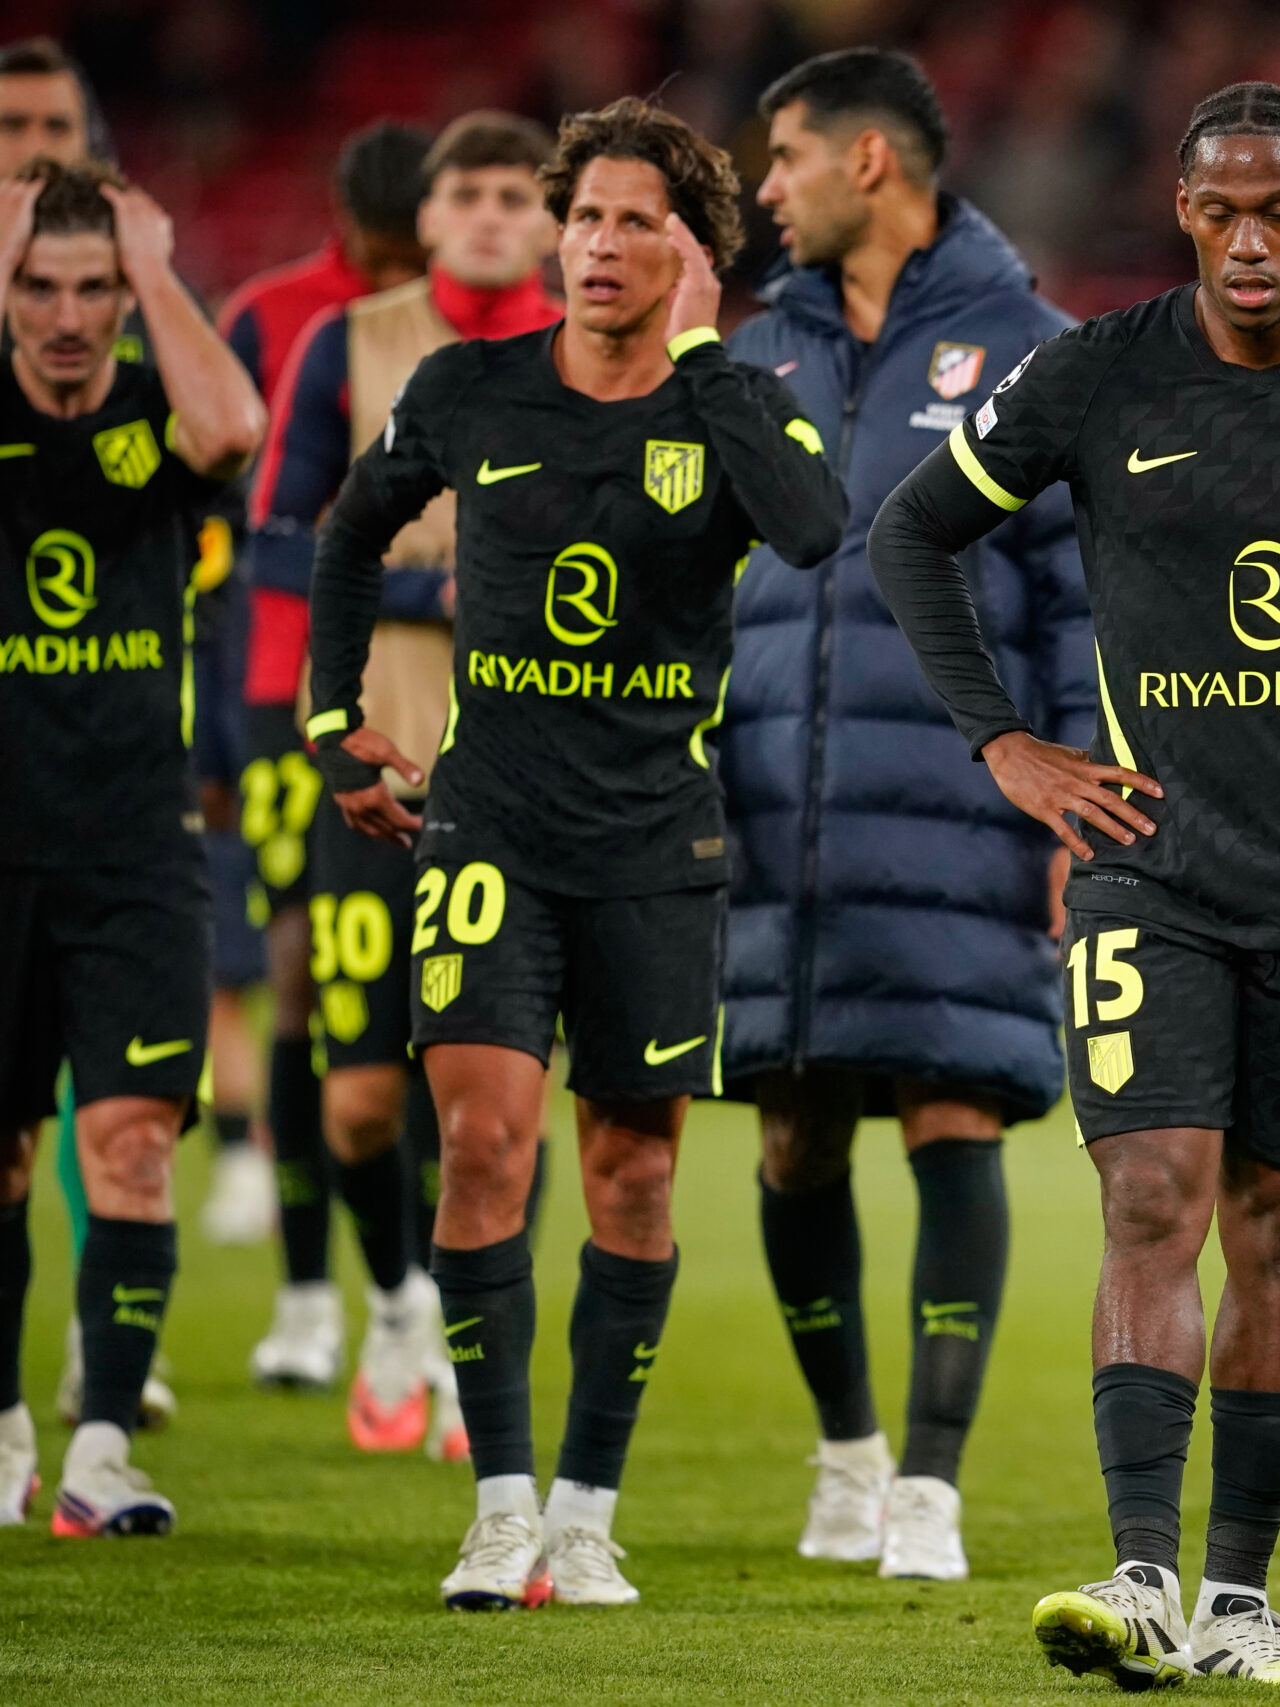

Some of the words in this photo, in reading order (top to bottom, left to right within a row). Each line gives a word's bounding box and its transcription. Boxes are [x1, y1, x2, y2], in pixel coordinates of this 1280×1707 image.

[103, 629, 163, 671] AIR
[468, 650, 614, 698] RIYADH
[621, 663, 695, 699] AIR
[411, 861, 506, 955] 20
[1067, 928, 1144, 1029] 15
